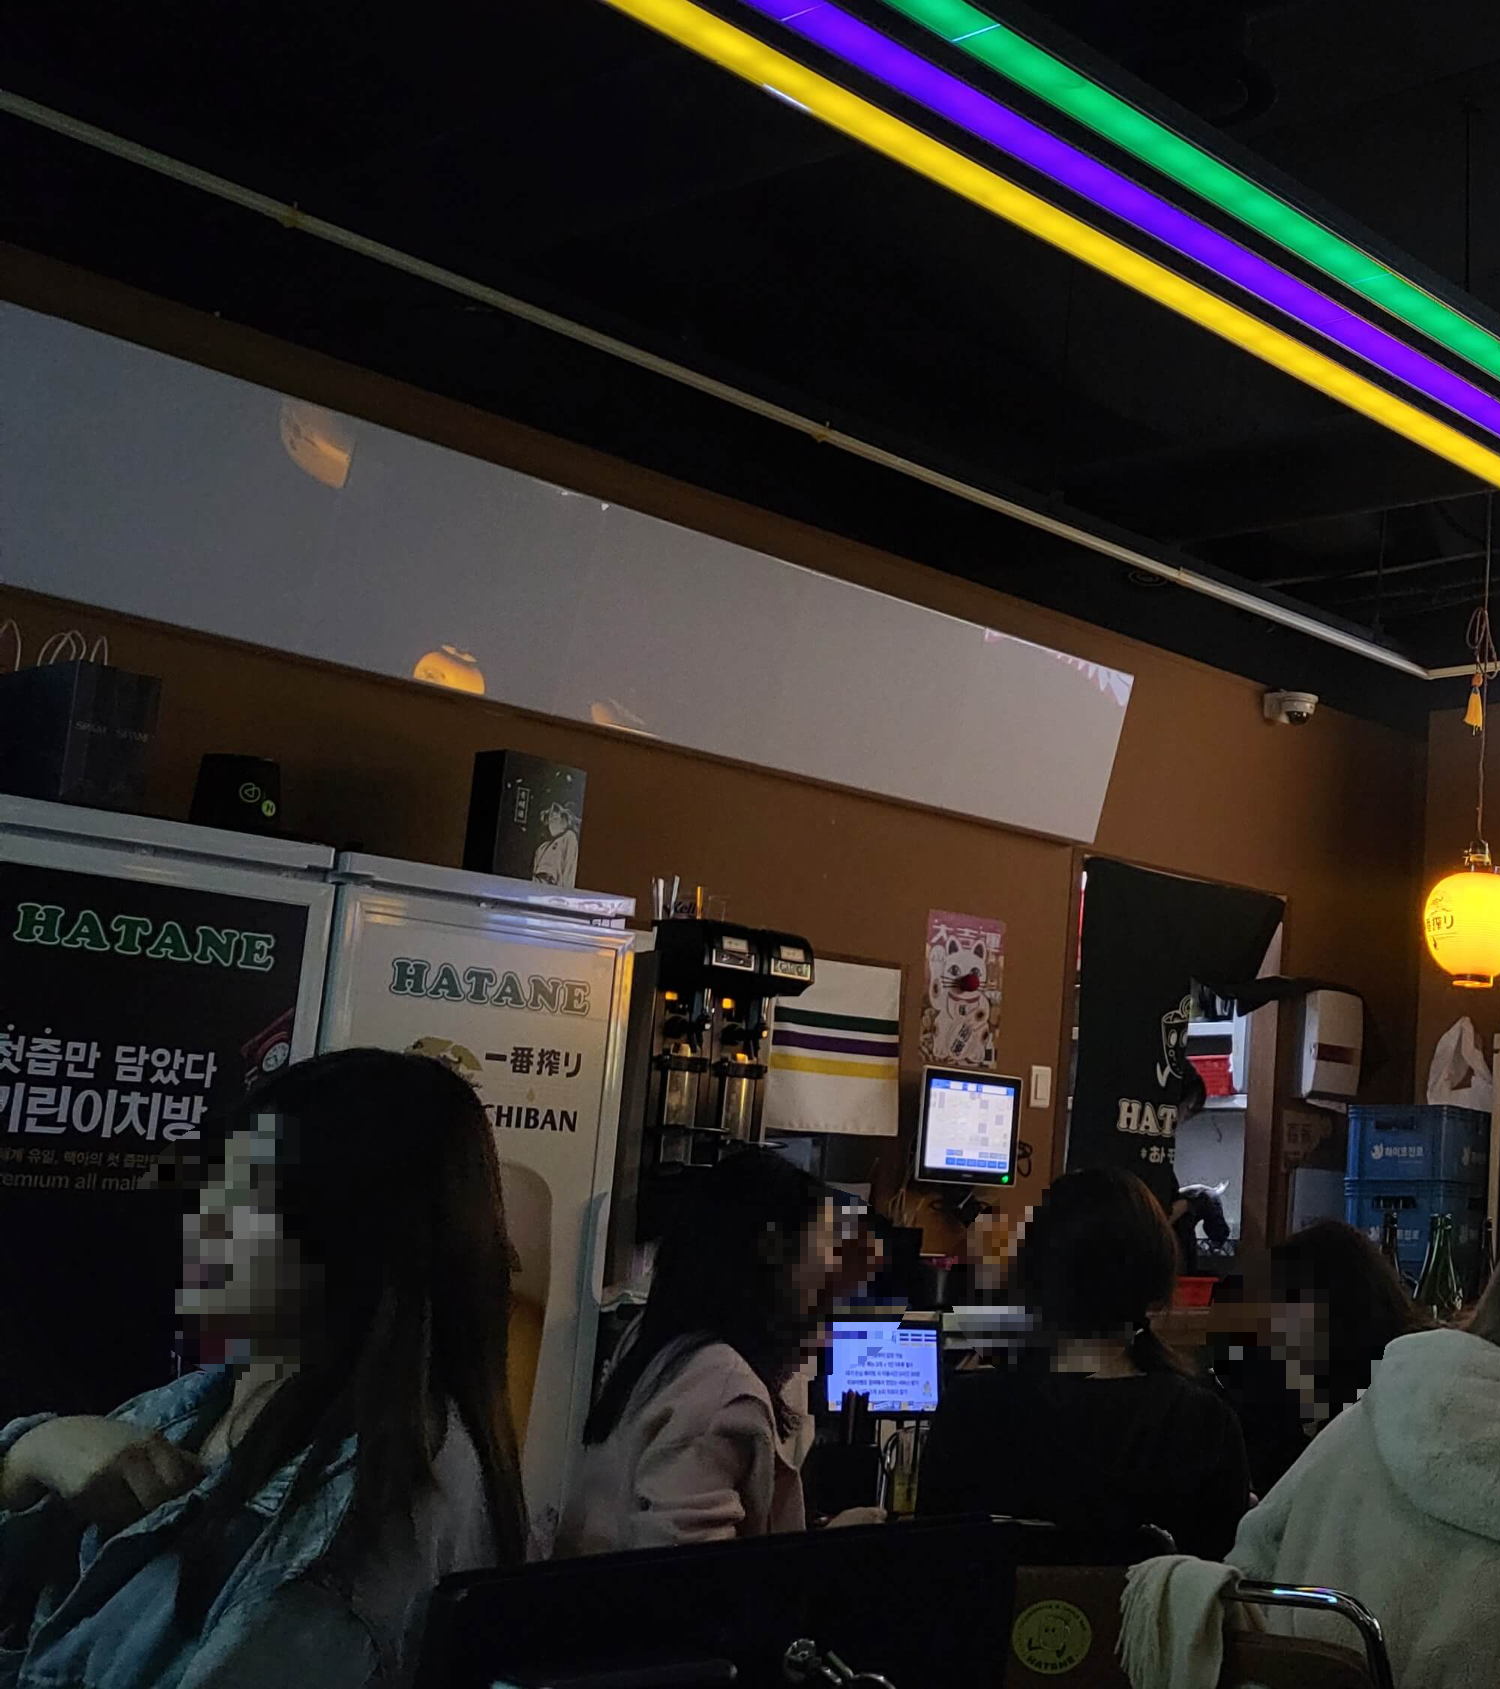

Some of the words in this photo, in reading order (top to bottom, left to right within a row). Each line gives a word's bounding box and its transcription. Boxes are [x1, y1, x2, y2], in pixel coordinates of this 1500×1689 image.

[13, 902, 276, 972] HATANE
[389, 957, 591, 1017] HATANE
[114, 1044, 218, 1089] 담았다
[485, 1046, 583, 1078] 一番搾り
[482, 1104, 578, 1132] HIBAN
[1116, 1097, 1178, 1138] HAT
[74, 1172, 98, 1190] all
